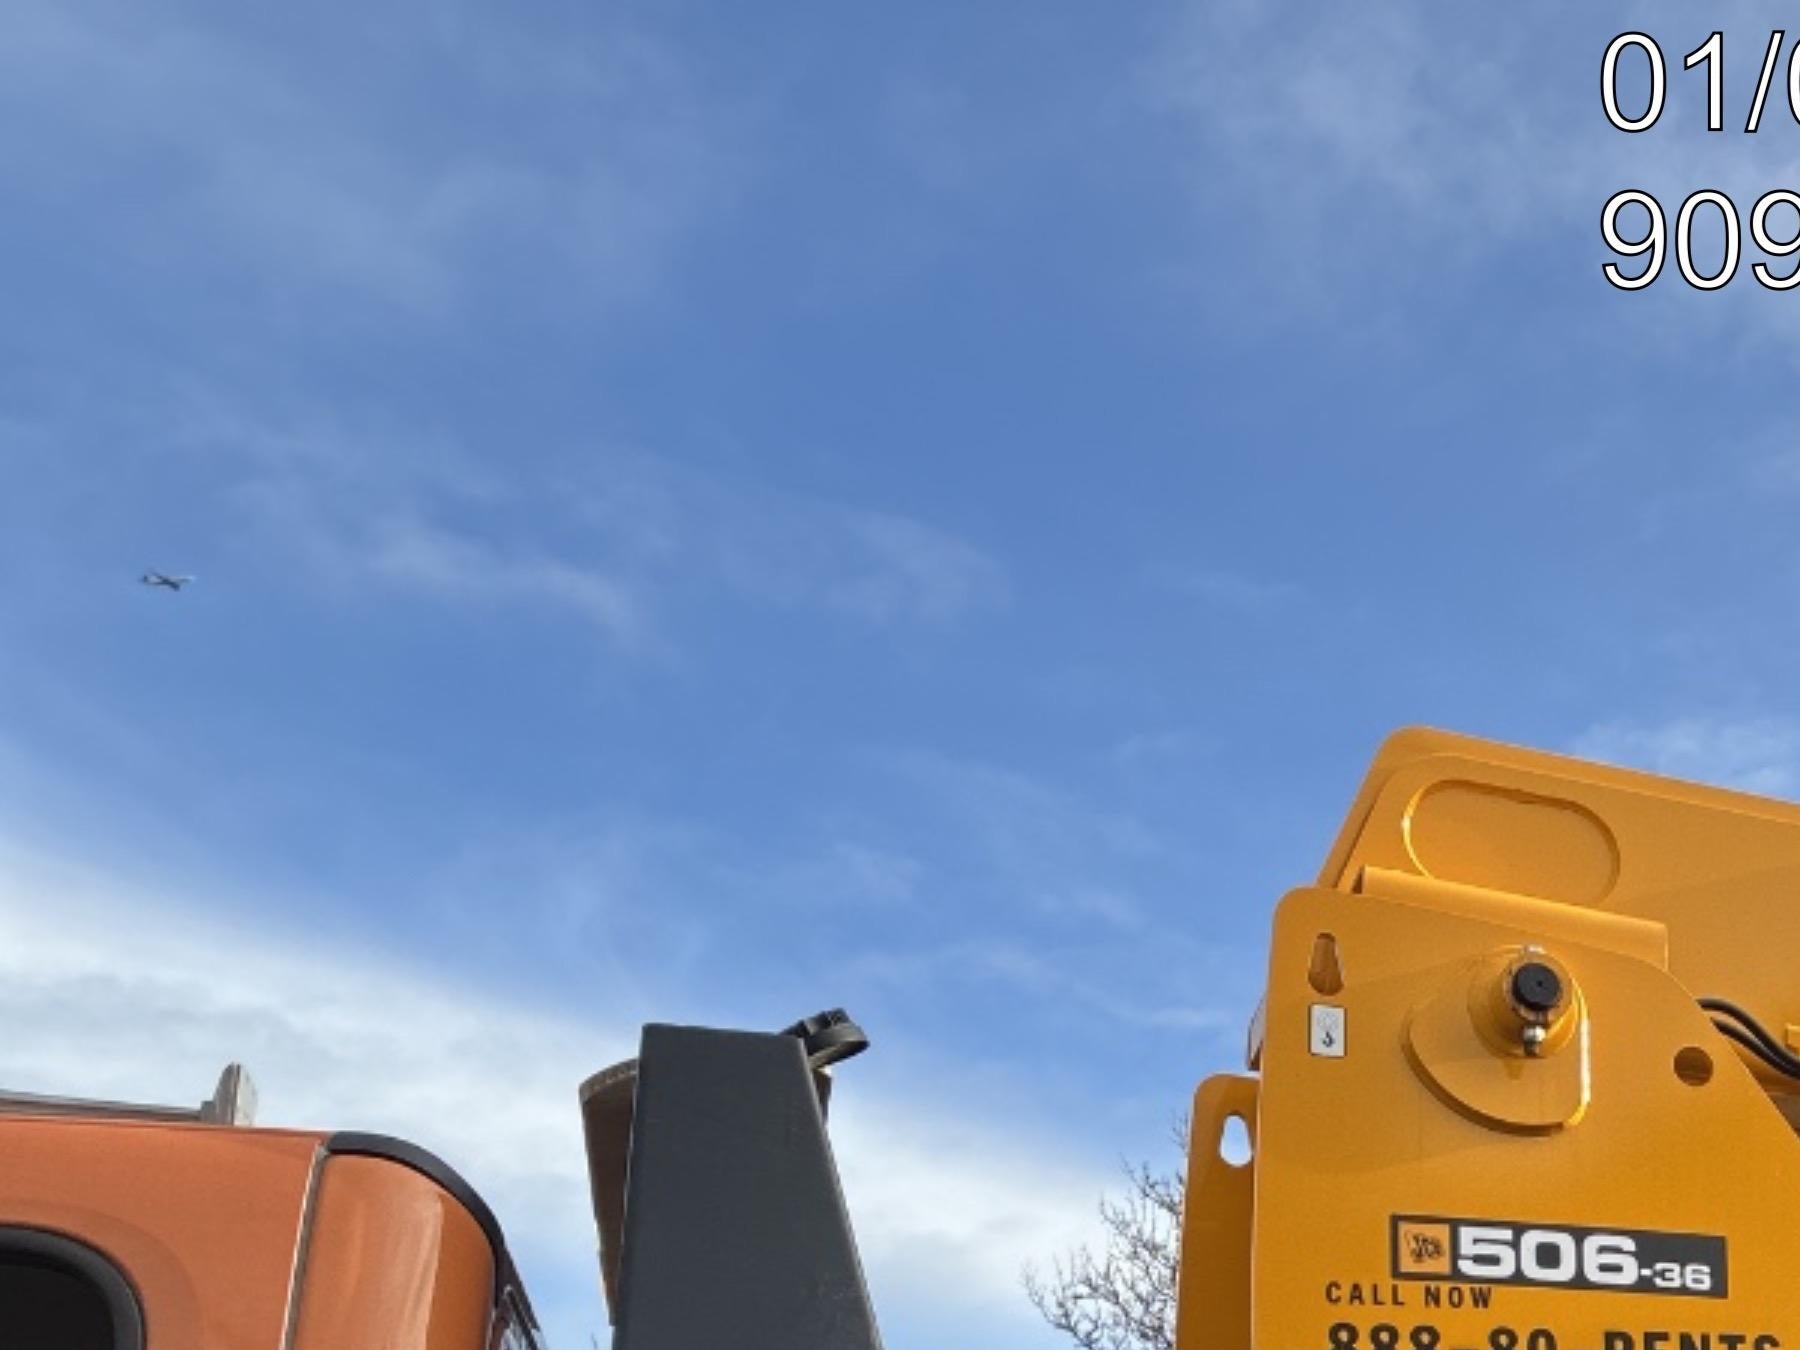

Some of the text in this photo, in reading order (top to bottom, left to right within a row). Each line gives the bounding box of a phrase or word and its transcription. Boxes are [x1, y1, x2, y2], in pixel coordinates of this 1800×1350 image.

[1456, 1225, 1712, 1291] 506-36
[1325, 1281, 1494, 1309] CALL NOW
